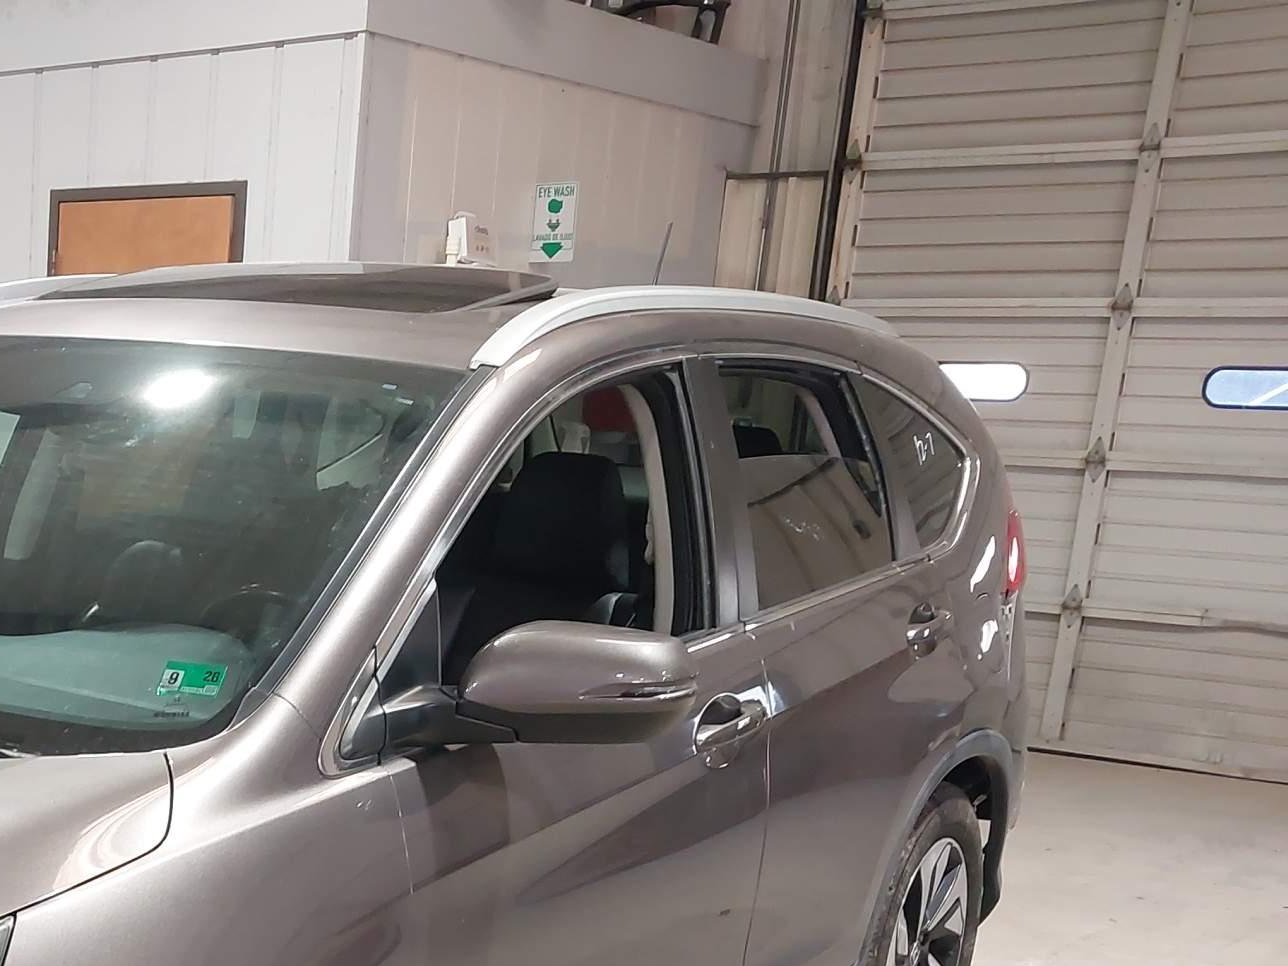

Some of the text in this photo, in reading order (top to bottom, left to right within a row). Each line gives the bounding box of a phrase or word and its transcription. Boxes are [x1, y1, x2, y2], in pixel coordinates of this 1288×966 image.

[538, 186, 575, 198] EYE WASH
[168, 672, 179, 685] 9
